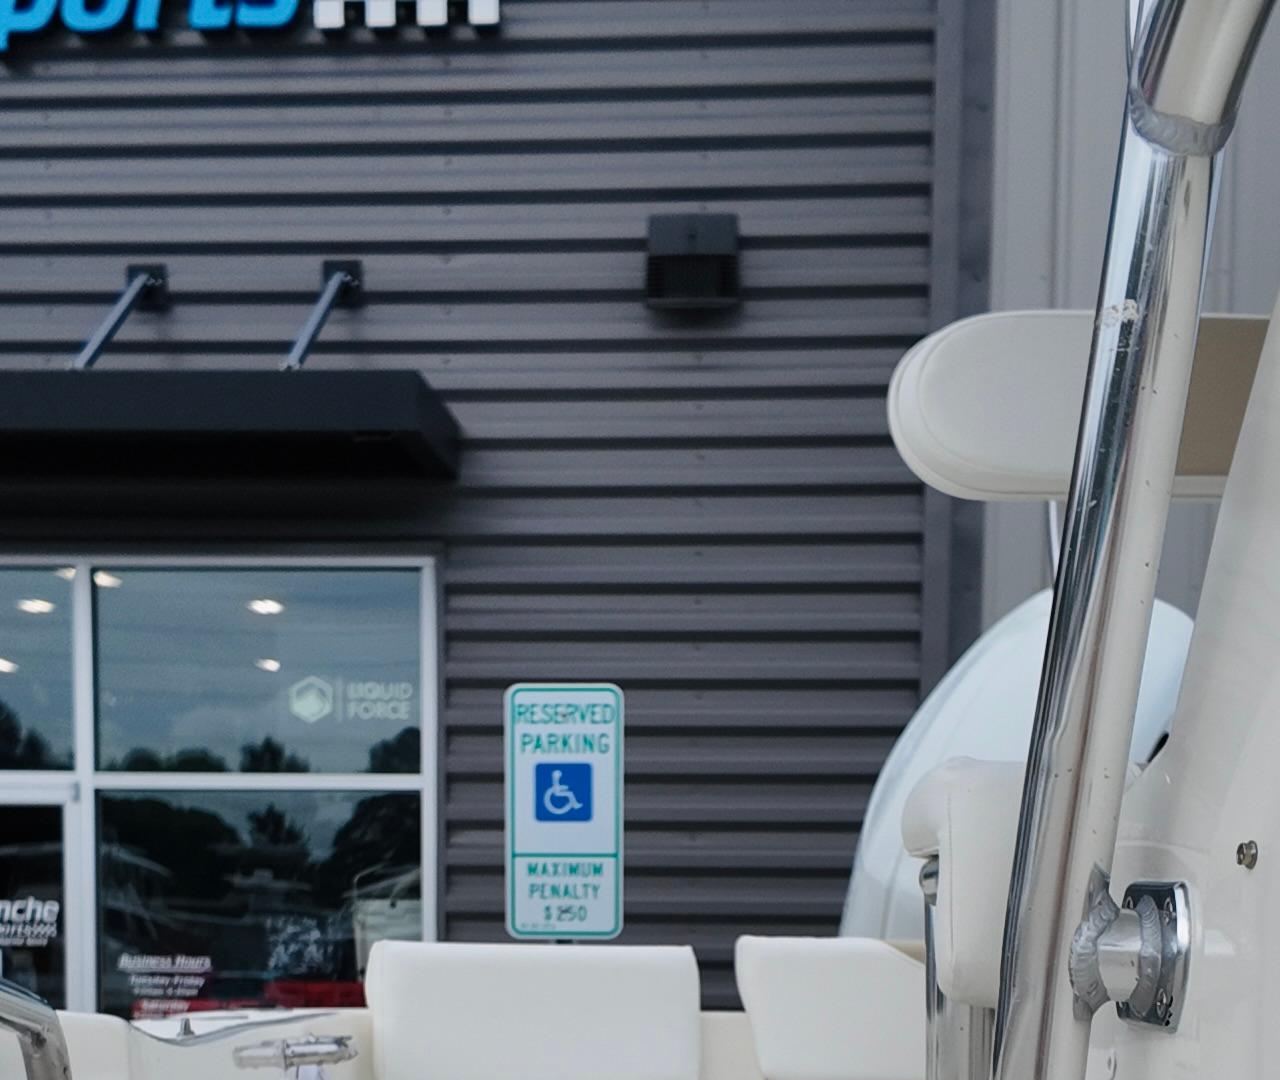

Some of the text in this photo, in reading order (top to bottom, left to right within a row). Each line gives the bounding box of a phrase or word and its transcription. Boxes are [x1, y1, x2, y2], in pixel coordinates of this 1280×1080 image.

[347, 682, 413, 699] LIQUID
[346, 702, 411, 719] FORCE
[516, 703, 615, 724] RESERVED
[521, 733, 610, 754] PARKING
[528, 862, 603, 877] MAXIMUM
[529, 883, 601, 899] PENALTY
[118, 954, 211, 970] Business Hours
